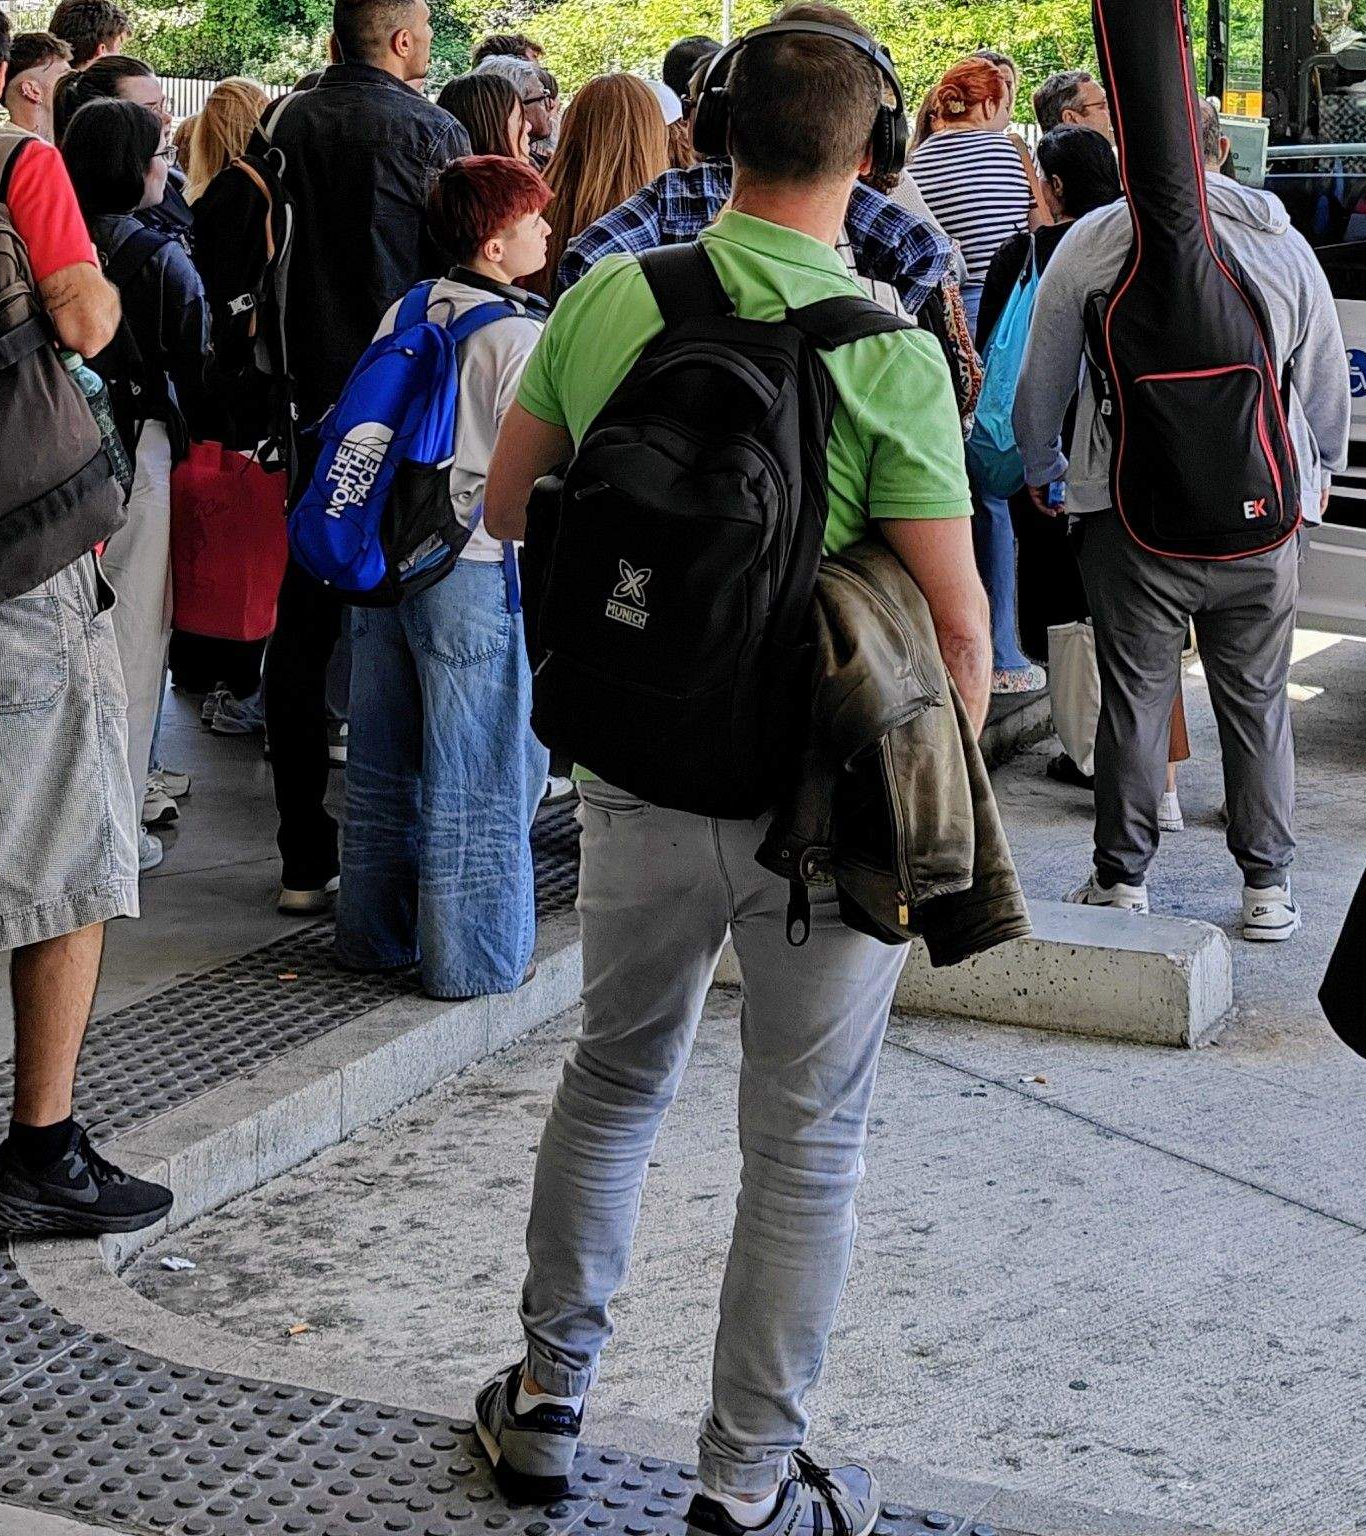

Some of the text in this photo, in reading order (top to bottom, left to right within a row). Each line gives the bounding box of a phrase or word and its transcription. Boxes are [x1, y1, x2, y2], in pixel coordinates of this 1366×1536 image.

[325, 444, 354, 482] THE
[348, 457, 381, 507] FACE
[325, 451, 368, 519] NORTH
[1243, 498, 1267, 519] EK
[605, 600, 648, 628] MUNICH
